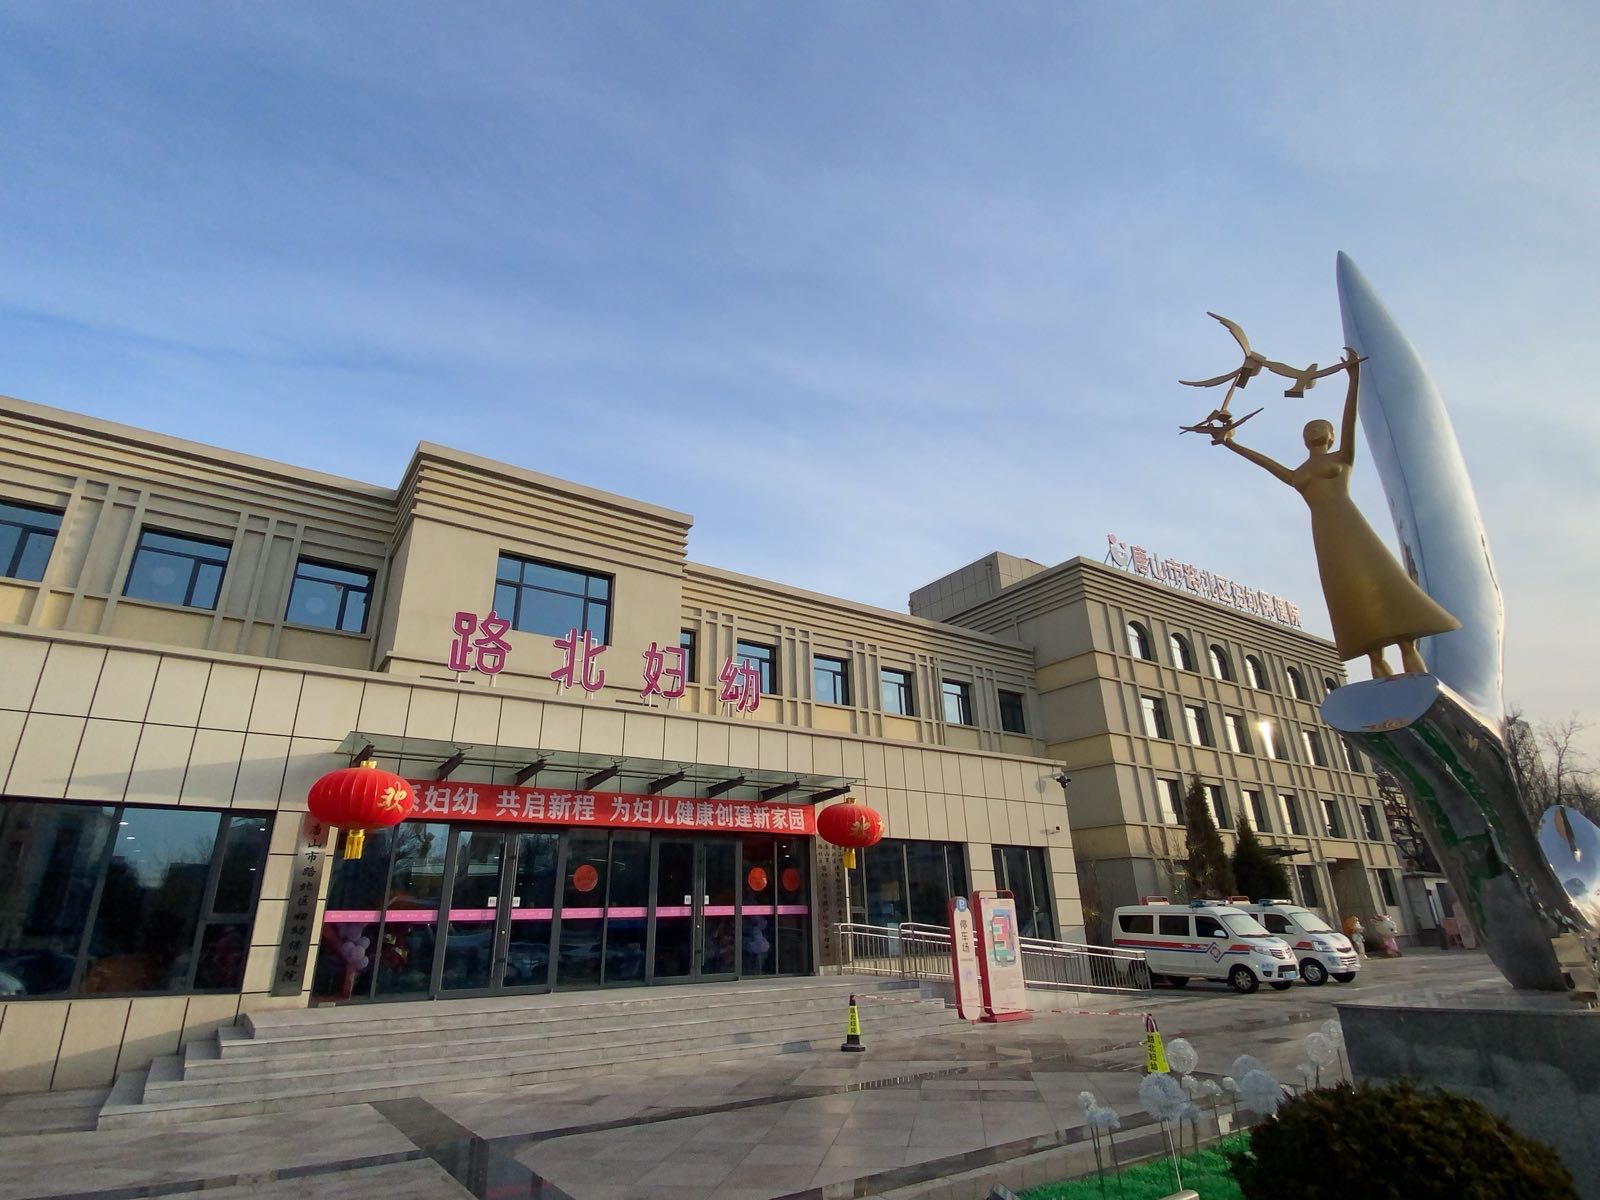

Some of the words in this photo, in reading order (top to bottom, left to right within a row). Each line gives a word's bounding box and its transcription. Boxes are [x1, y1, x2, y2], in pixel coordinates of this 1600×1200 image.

[448, 610, 761, 713] 路北妇幼
[496, 790, 595, 822] 共启新程
[610, 796, 806, 831] 为妇儿健康创建新家园
